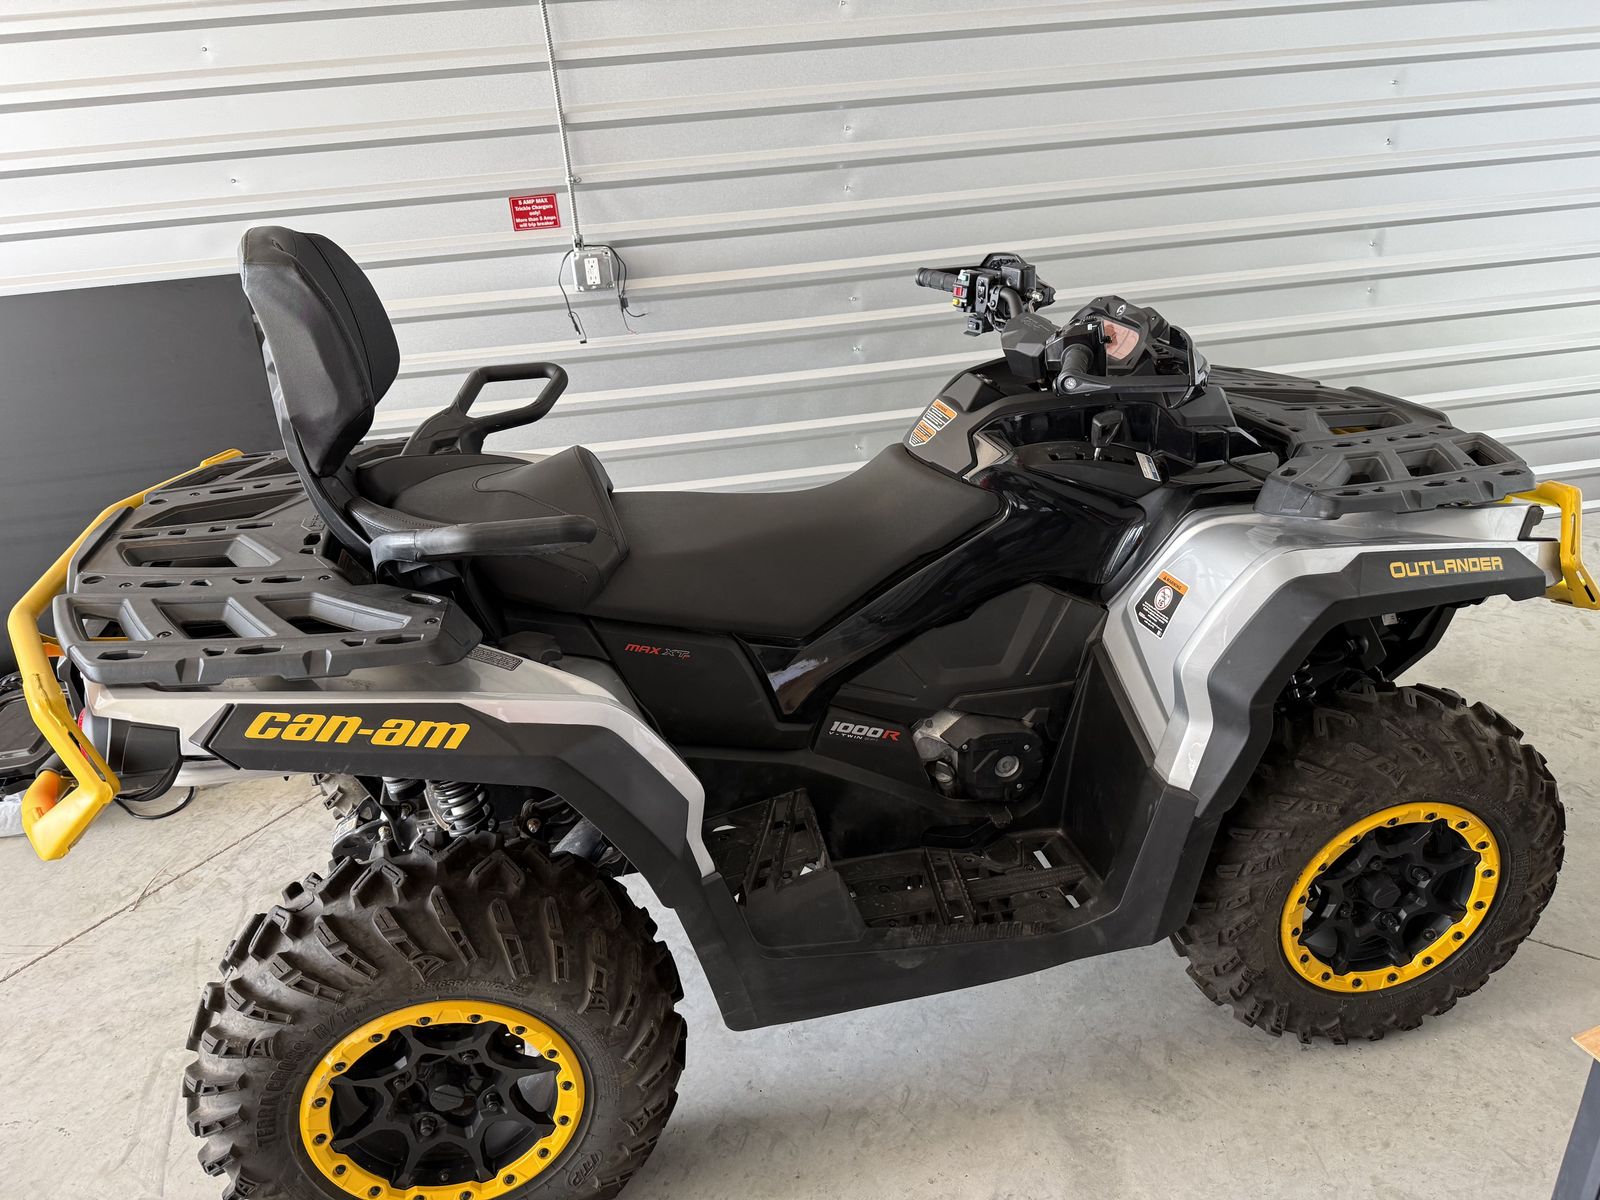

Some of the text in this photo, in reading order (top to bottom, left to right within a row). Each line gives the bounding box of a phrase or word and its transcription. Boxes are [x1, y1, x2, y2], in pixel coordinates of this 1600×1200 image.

[1389, 556, 1504, 579] OUTLANDER
[624, 643, 661, 655] MAX
[244, 711, 471, 750] can-am
[828, 731, 863, 740] V-TWIN
[830, 721, 901, 741] 1000R
